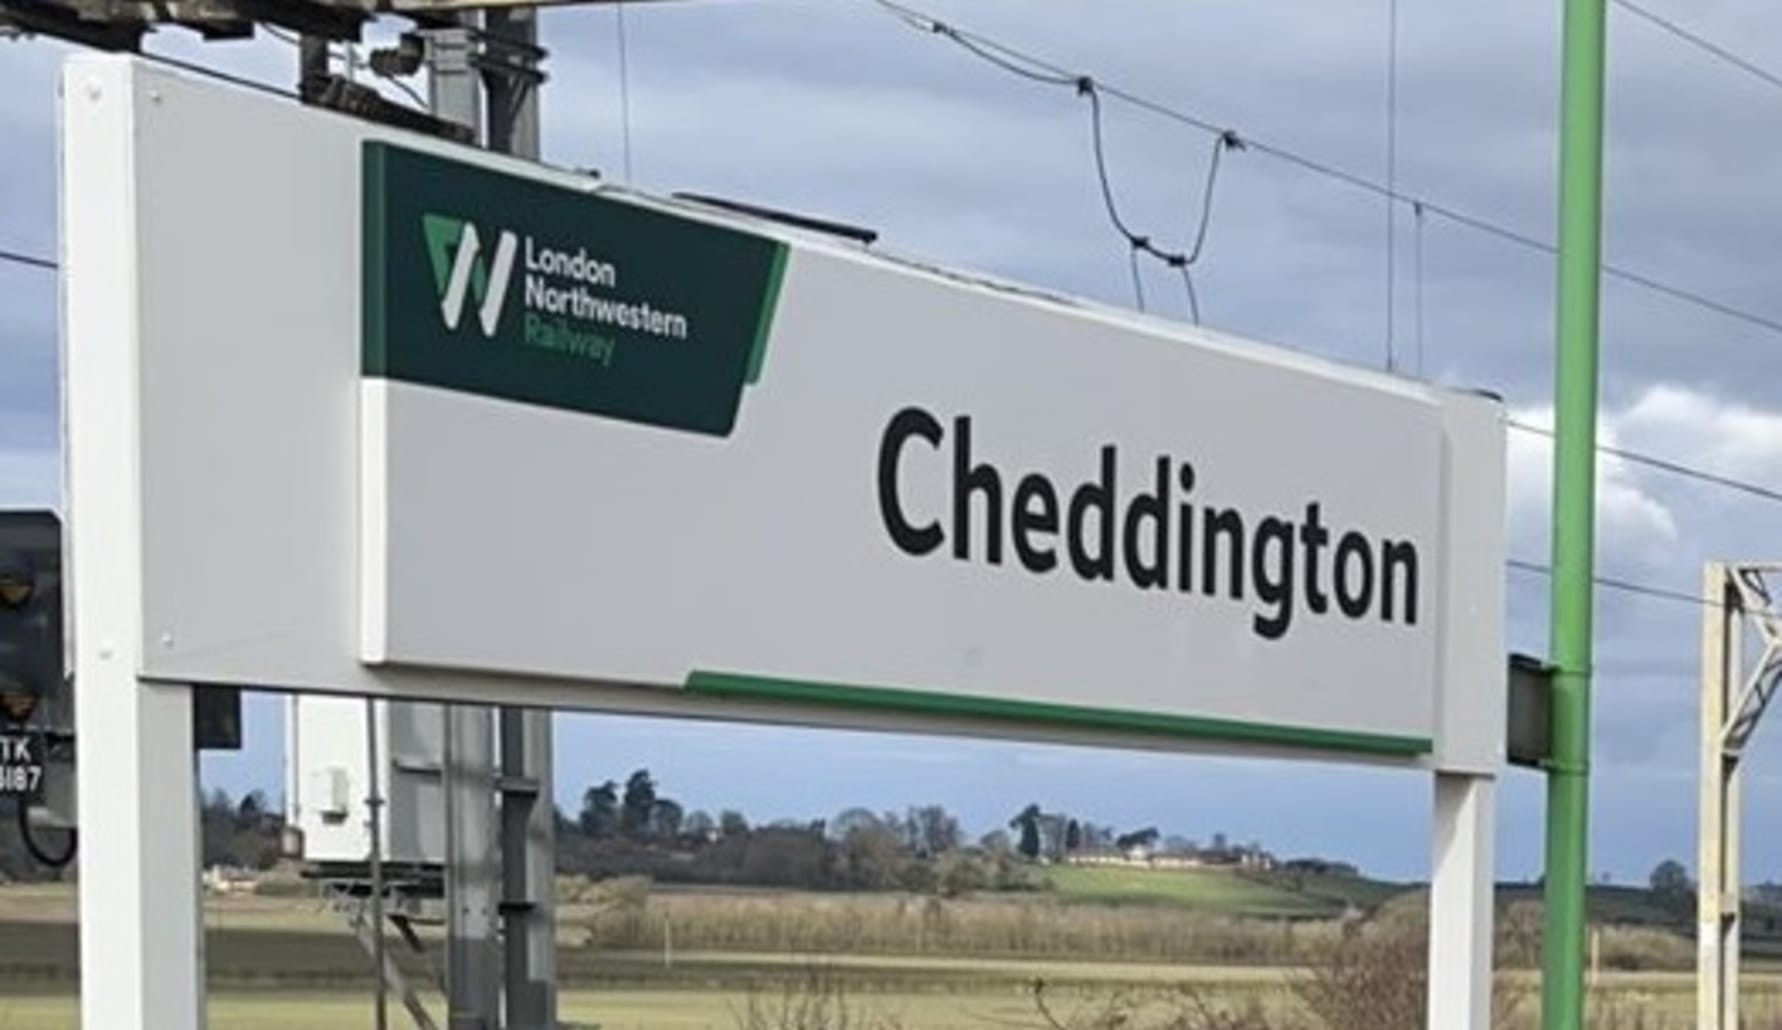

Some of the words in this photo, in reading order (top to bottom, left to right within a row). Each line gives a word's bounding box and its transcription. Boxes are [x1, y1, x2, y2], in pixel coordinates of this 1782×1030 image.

[525, 235, 616, 287] London
[525, 274, 688, 339] Northwestern
[525, 313, 616, 366] Railway
[877, 406, 1419, 640] Cheddington
